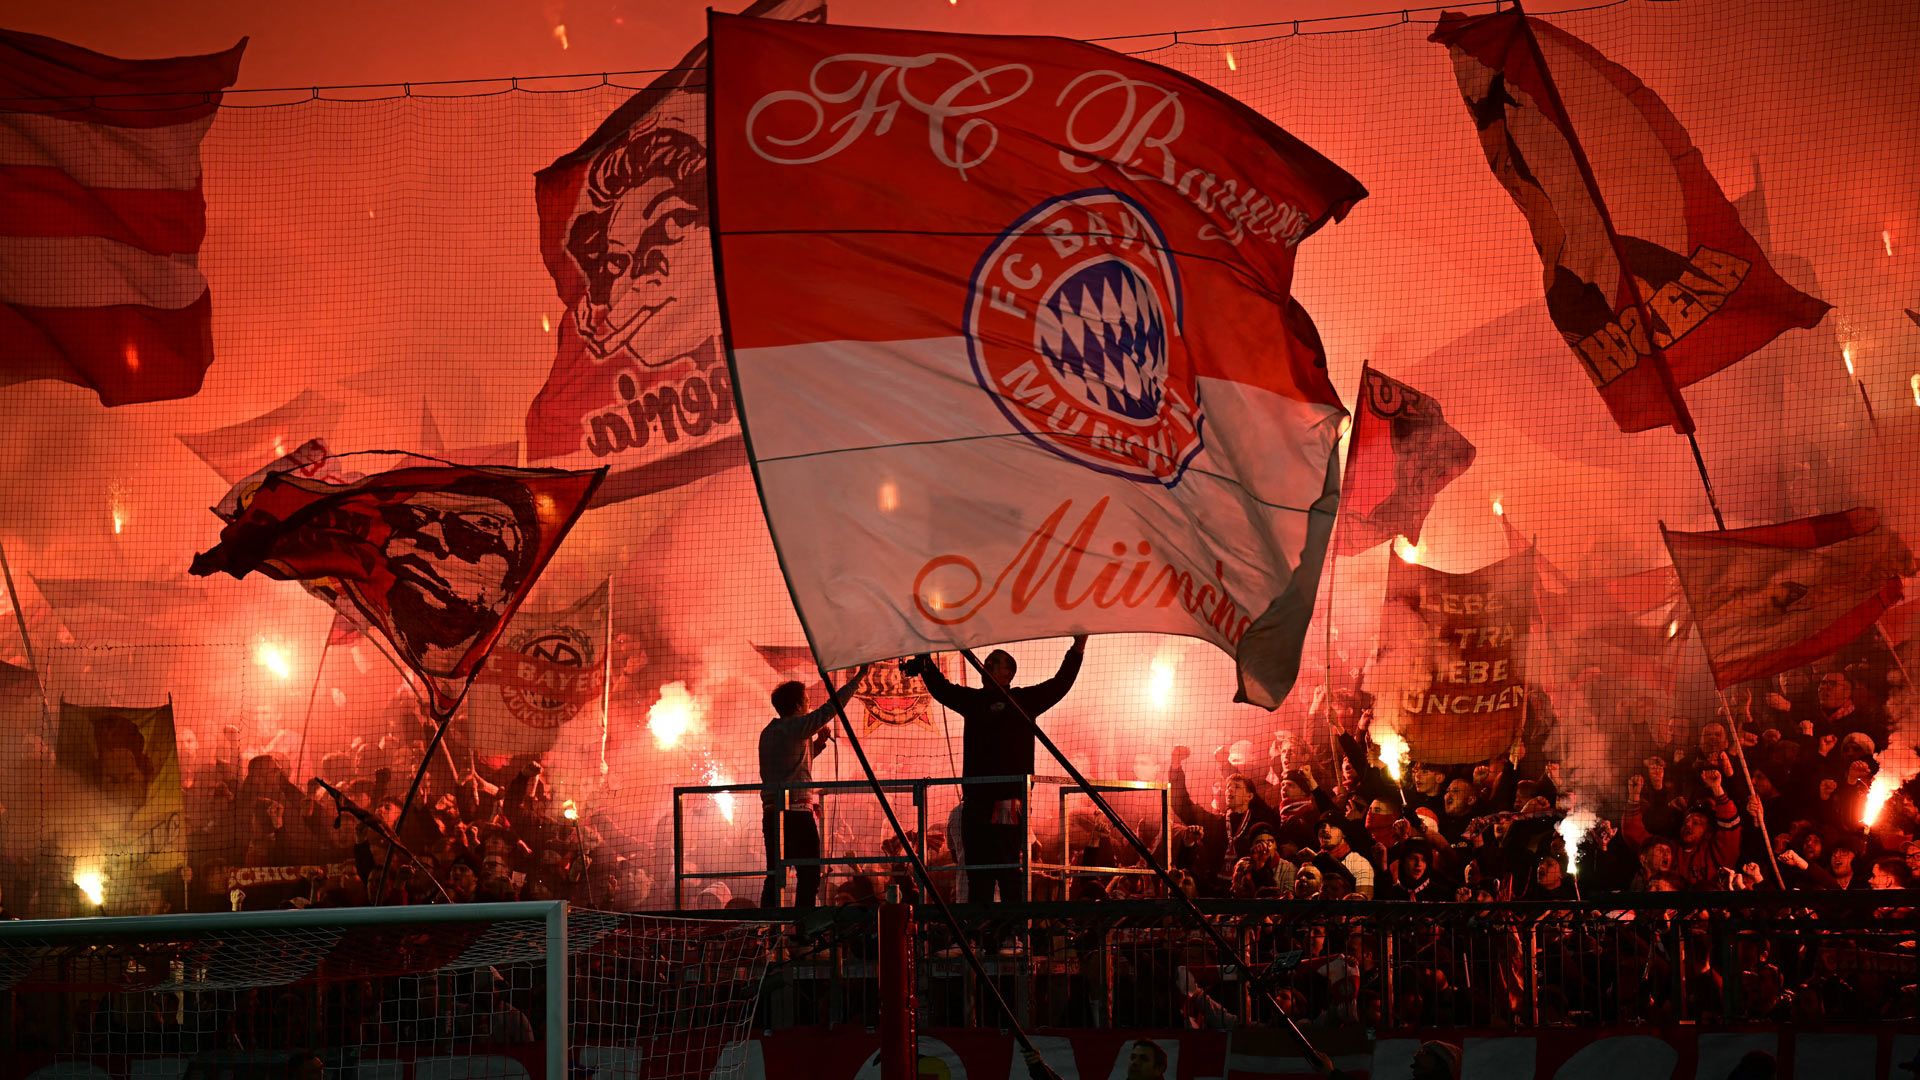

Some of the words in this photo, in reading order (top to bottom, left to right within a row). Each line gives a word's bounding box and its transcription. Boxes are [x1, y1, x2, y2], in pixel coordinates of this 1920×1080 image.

[745, 52, 1034, 182] FC
[989, 252, 1043, 320] FC
[1042, 210, 1160, 269] BAY
